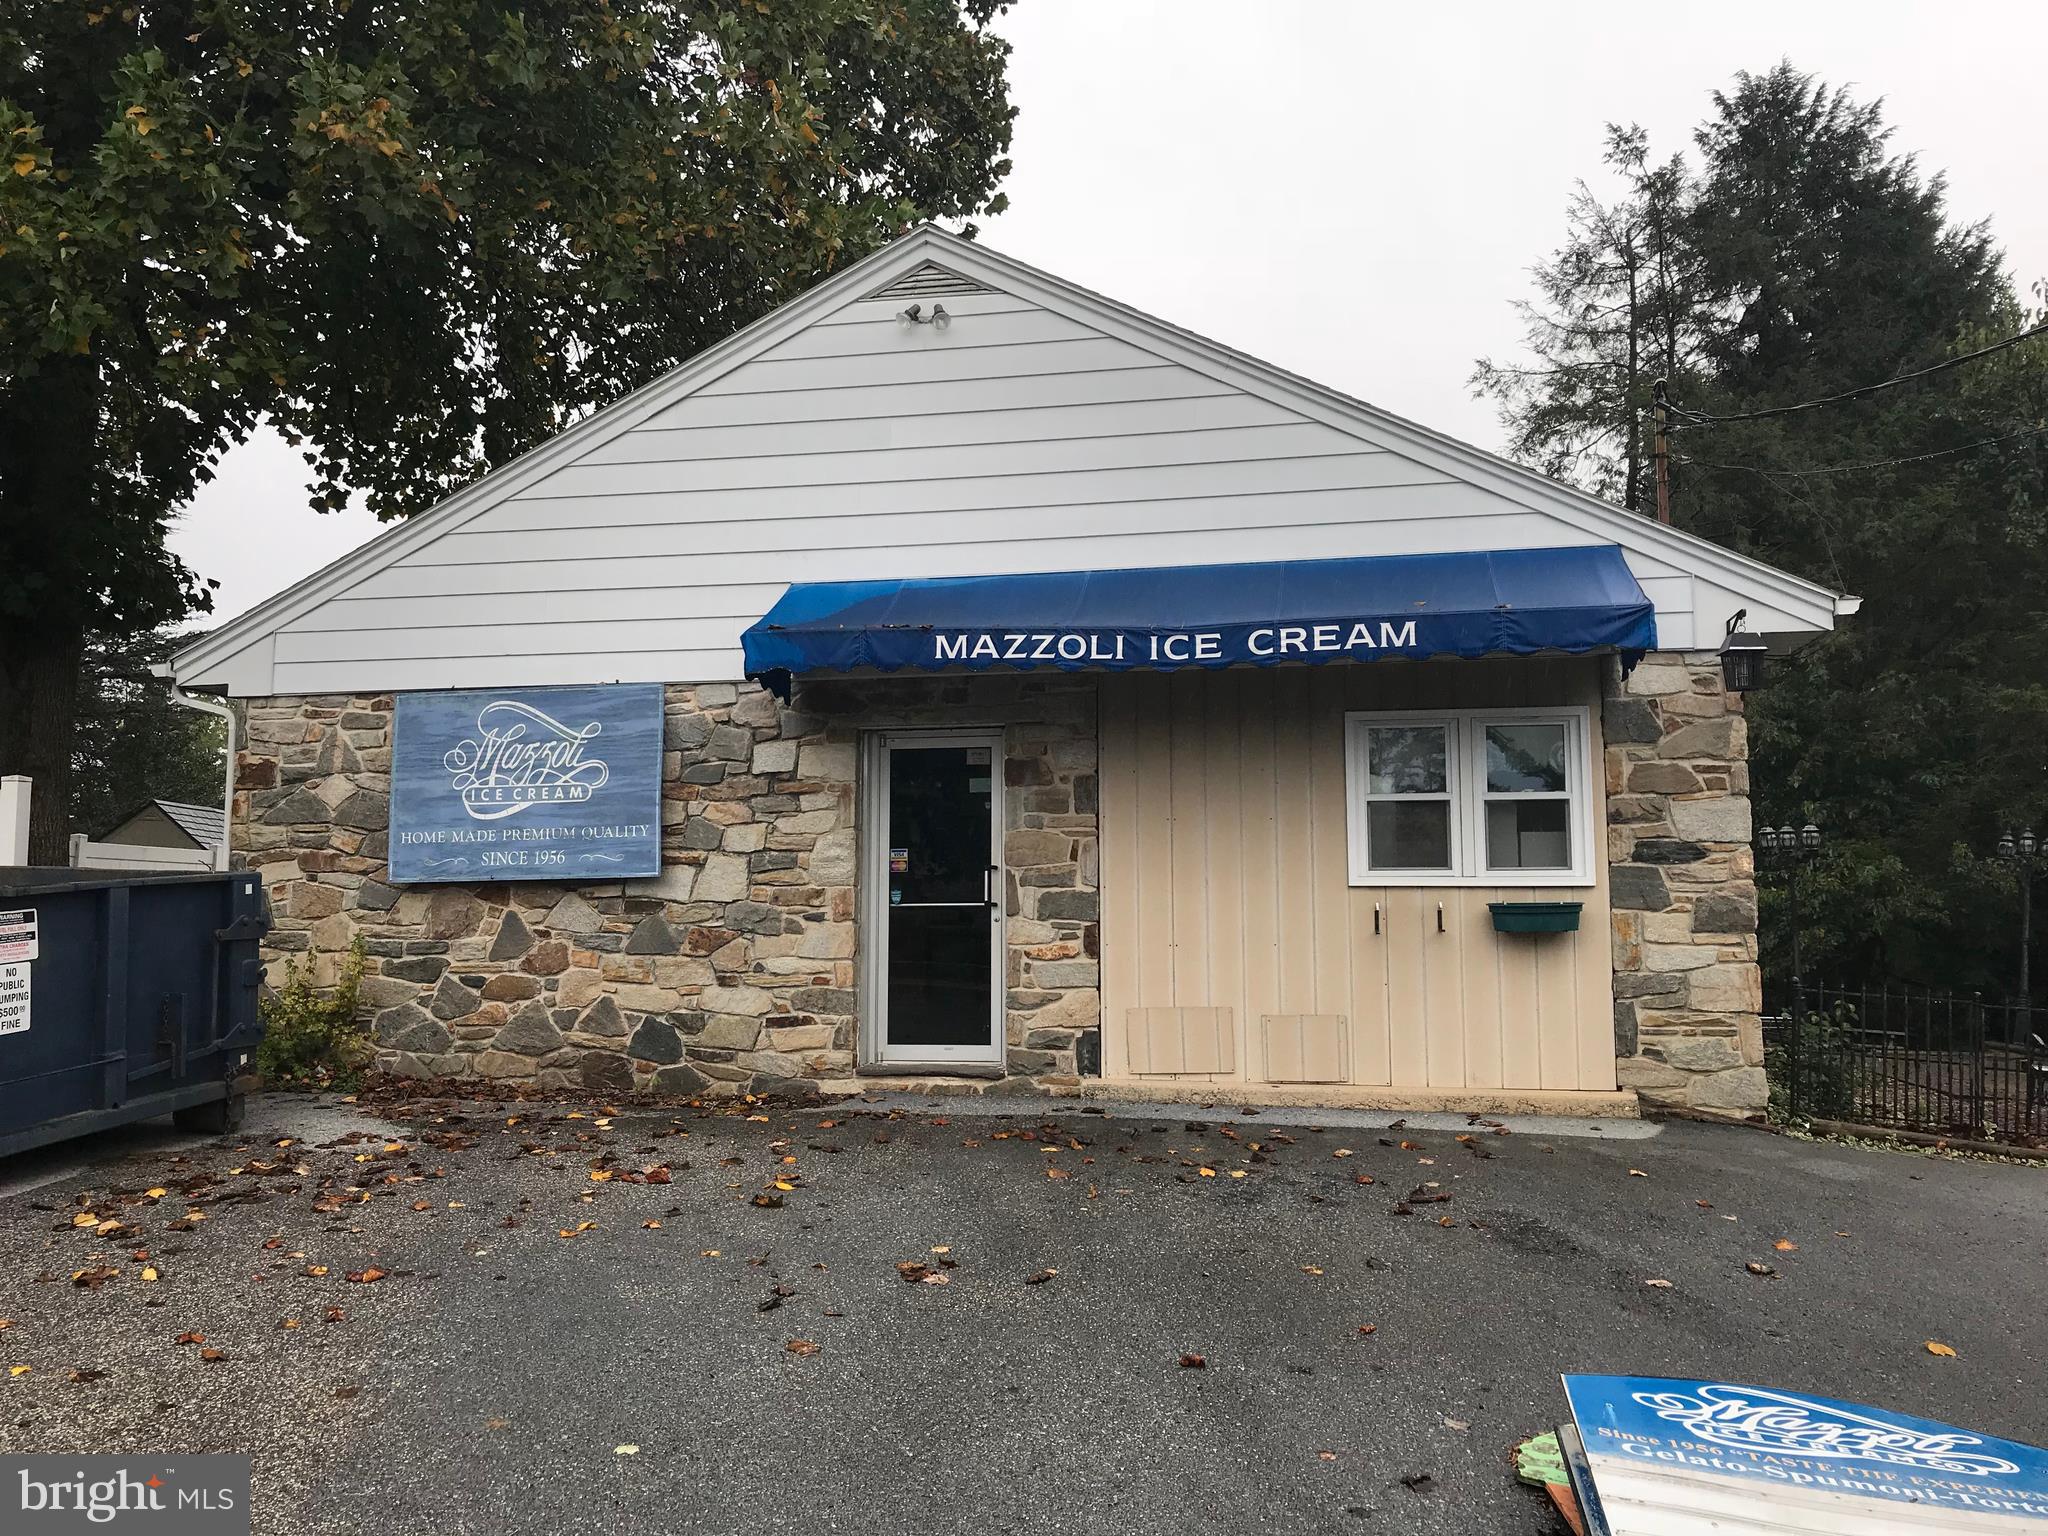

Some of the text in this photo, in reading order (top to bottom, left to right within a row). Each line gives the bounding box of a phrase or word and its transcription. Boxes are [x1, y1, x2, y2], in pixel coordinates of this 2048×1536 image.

[934, 620, 1418, 660] MAZZOLI ICE CREAM
[450, 715, 603, 788] Mazzoli
[470, 786, 583, 801] ICE CREAM
[401, 824, 649, 844] HOME MADE PREMIUM QUALITY
[481, 850, 566, 866] SINCE 1956
[6, 967, 17, 977] NO
[0, 979, 25, 990] PUBLIC
[0, 991, 29, 1004] UMPING
[1, 1018, 21, 1030] FINE
[1650, 1389, 1982, 1456] Mazzoli
[1704, 1424, 1766, 1442] ICE
[1782, 1436, 1918, 1465] CREAM
[1598, 1427, 1661, 1445] Since
[1667, 1439, 1724, 1456] 1956
[1841, 1466, 1898, 1481] THE
